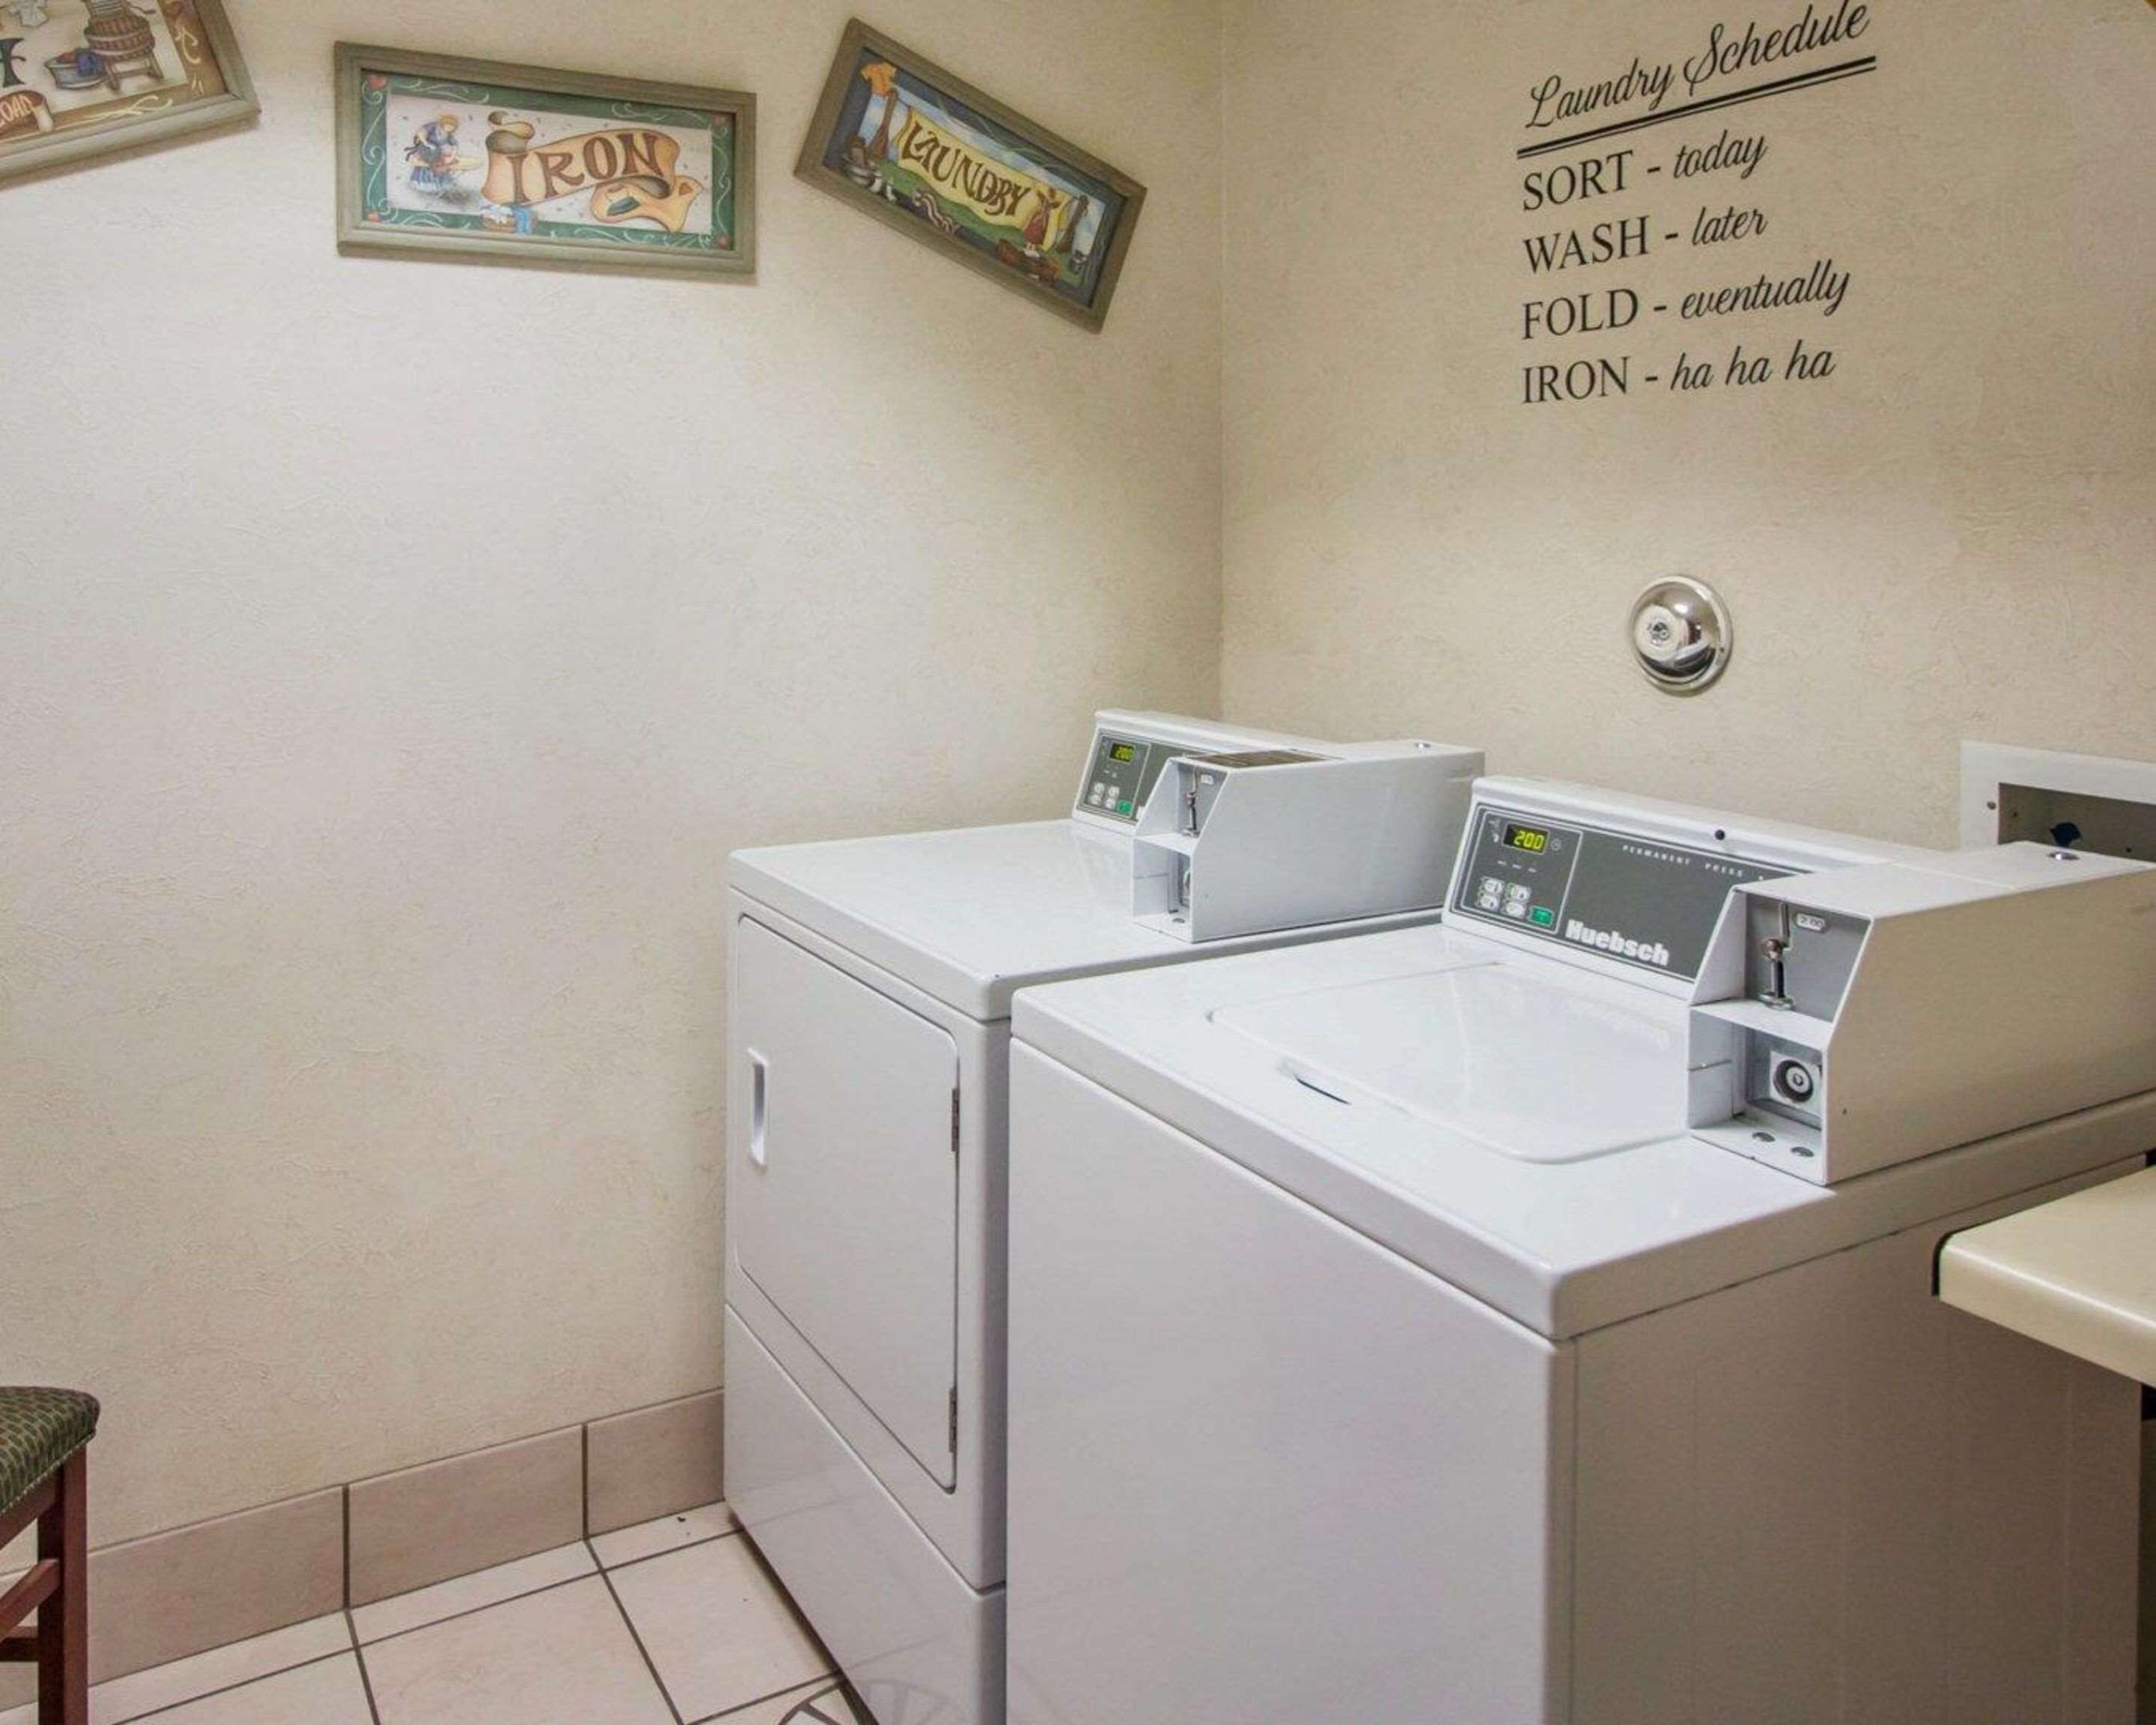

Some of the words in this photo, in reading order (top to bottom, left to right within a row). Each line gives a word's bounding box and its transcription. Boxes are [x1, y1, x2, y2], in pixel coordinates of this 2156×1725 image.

[1524, 57, 1675, 129] Laundry
[1682, 0, 1871, 97] Schedule
[506, 133, 665, 204] IRON
[901, 121, 1032, 216] LAUNDRY
[1523, 149, 1633, 212] SORT
[1672, 129, 1769, 180] today
[1522, 215, 1650, 274] WASH
[1691, 205, 1768, 246] later
[1522, 288, 1639, 341] FOLD
[1680, 258, 1851, 320] eventually
[1523, 356, 1630, 404] IRON
[1669, 352, 1714, 391] ha
[1724, 344, 1773, 386] ha
[1784, 338, 1836, 381] ha
[1514, 830, 1545, 851] 200
[1565, 919, 1669, 966] Huebsch
